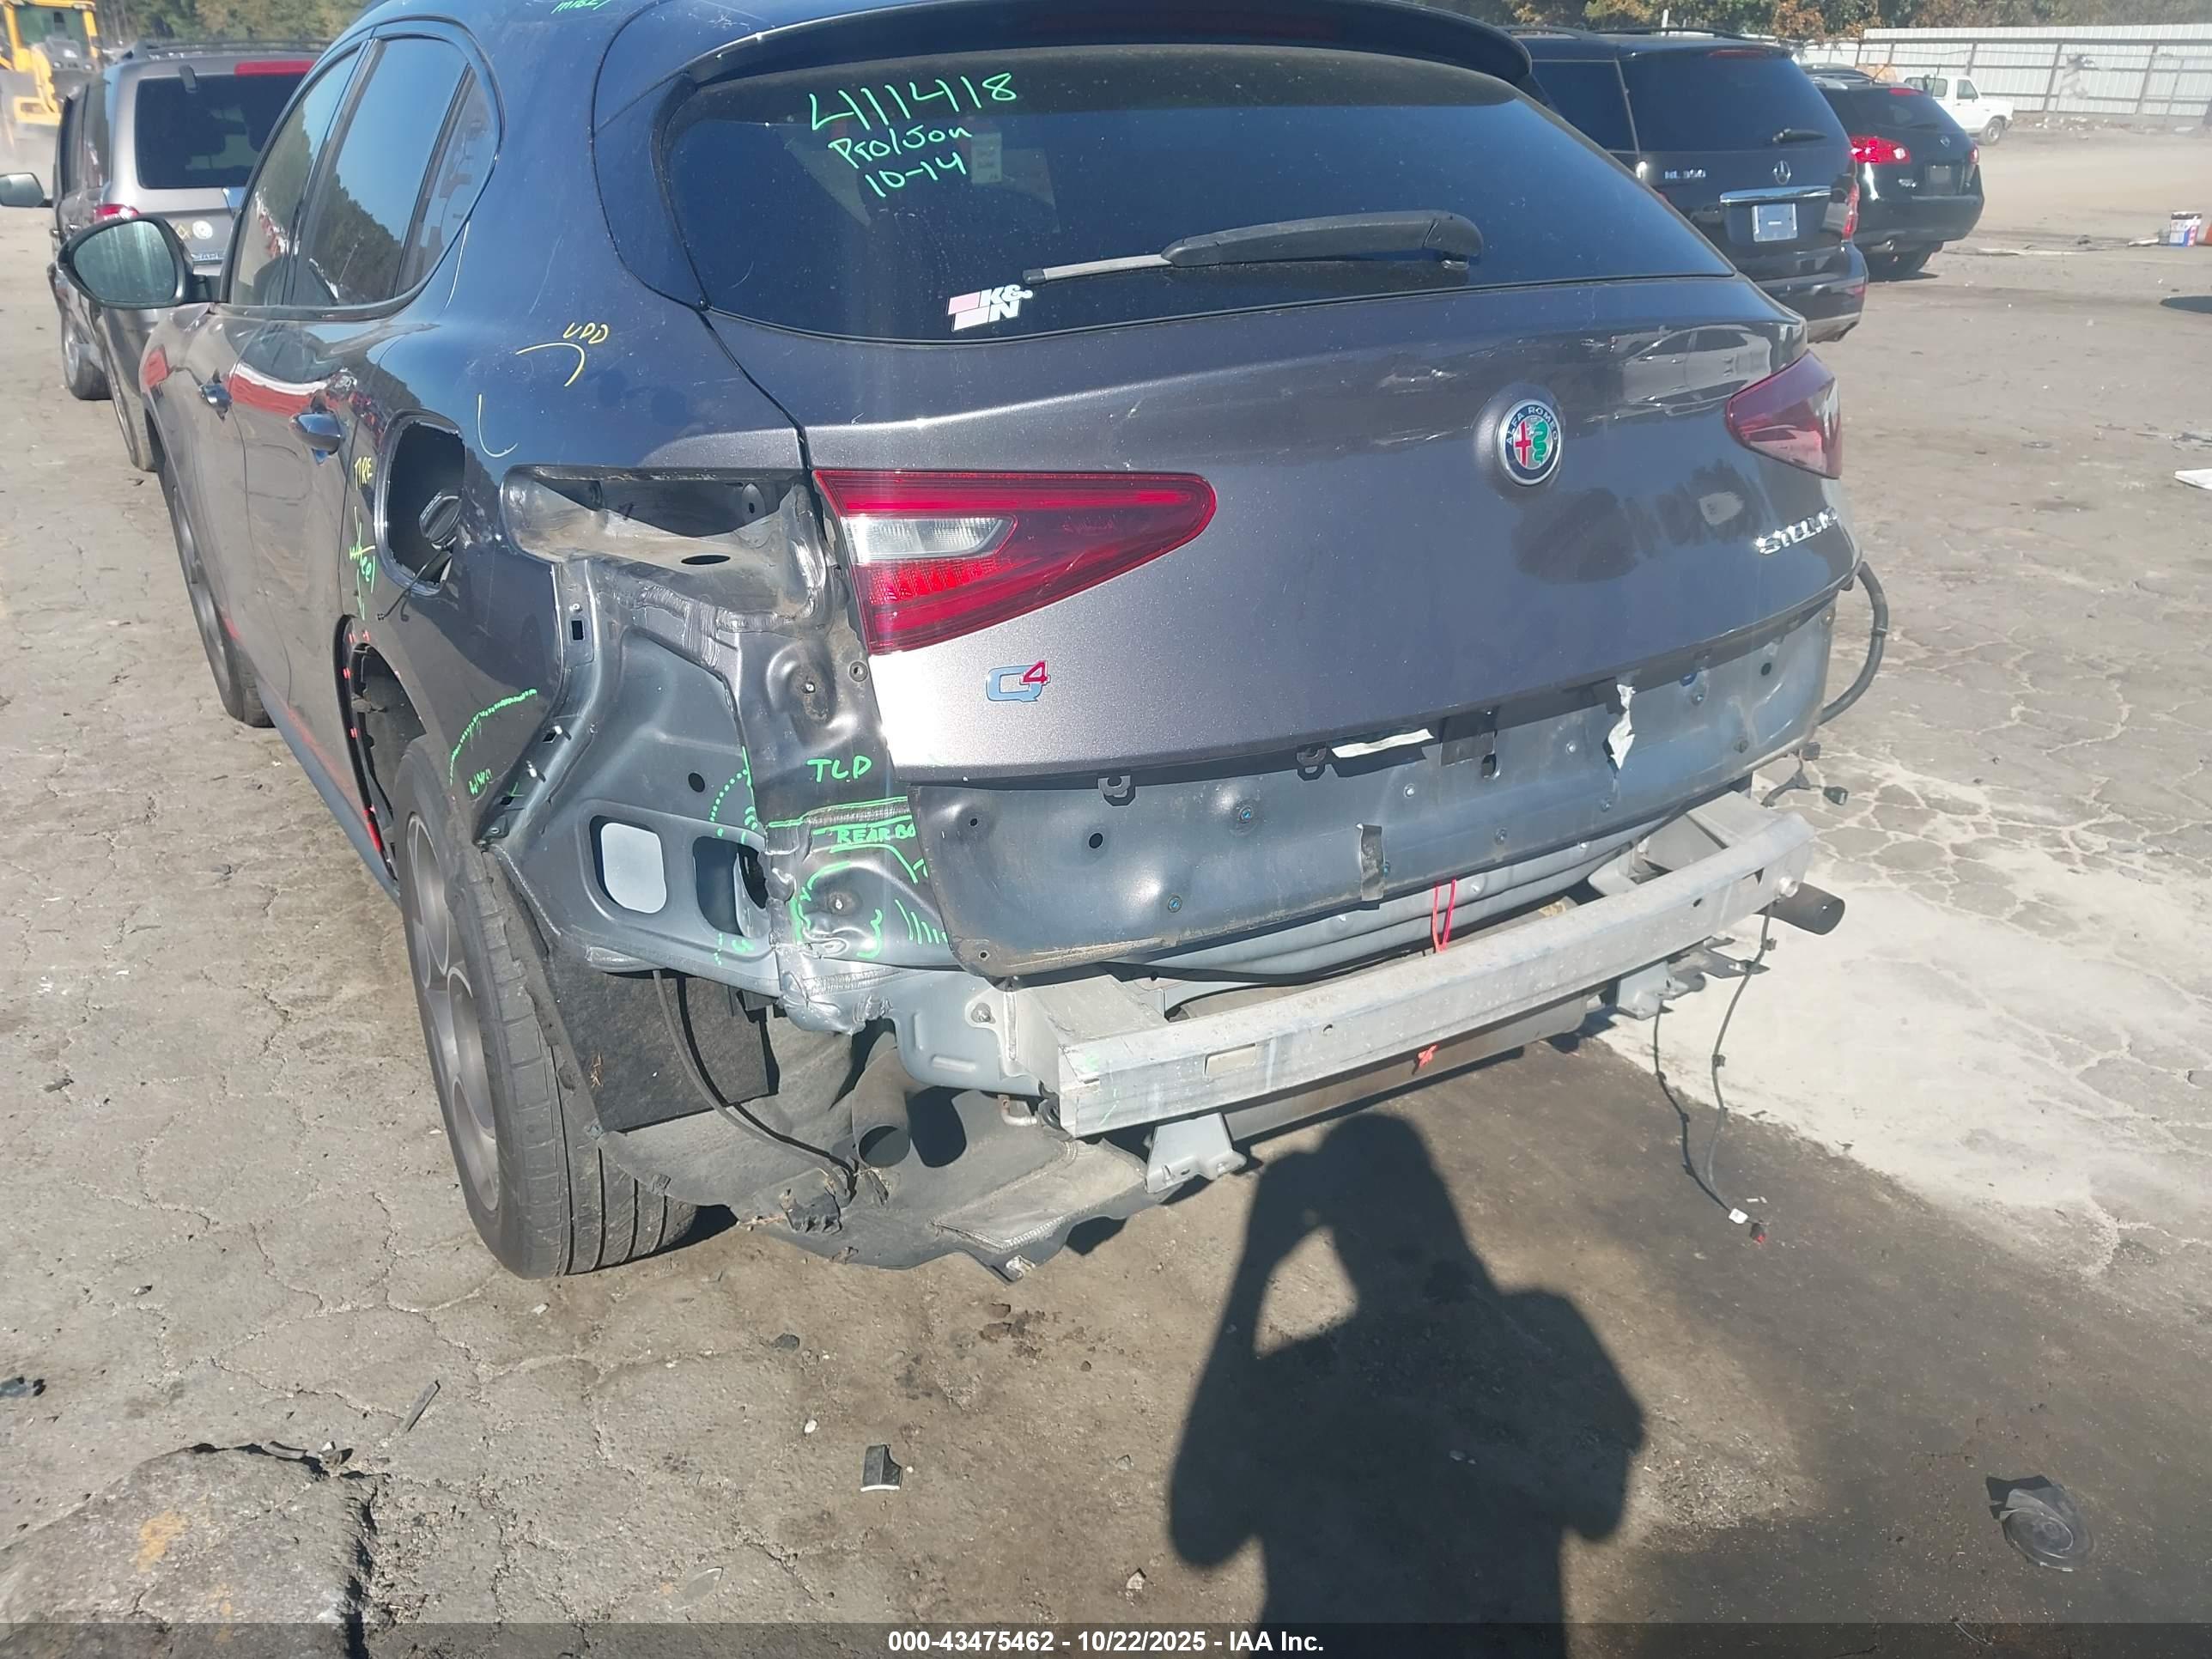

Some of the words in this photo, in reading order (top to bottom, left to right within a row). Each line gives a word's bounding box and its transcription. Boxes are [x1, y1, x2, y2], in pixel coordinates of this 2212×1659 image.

[809, 72, 1017, 131] 411418
[865, 151, 966, 198] 10-14
[1506, 413, 1525, 445] ALFA
[1528, 406, 1559, 441] ROMEO
[806, 755, 872, 783] TLD
[836, 827, 890, 844] REAR
